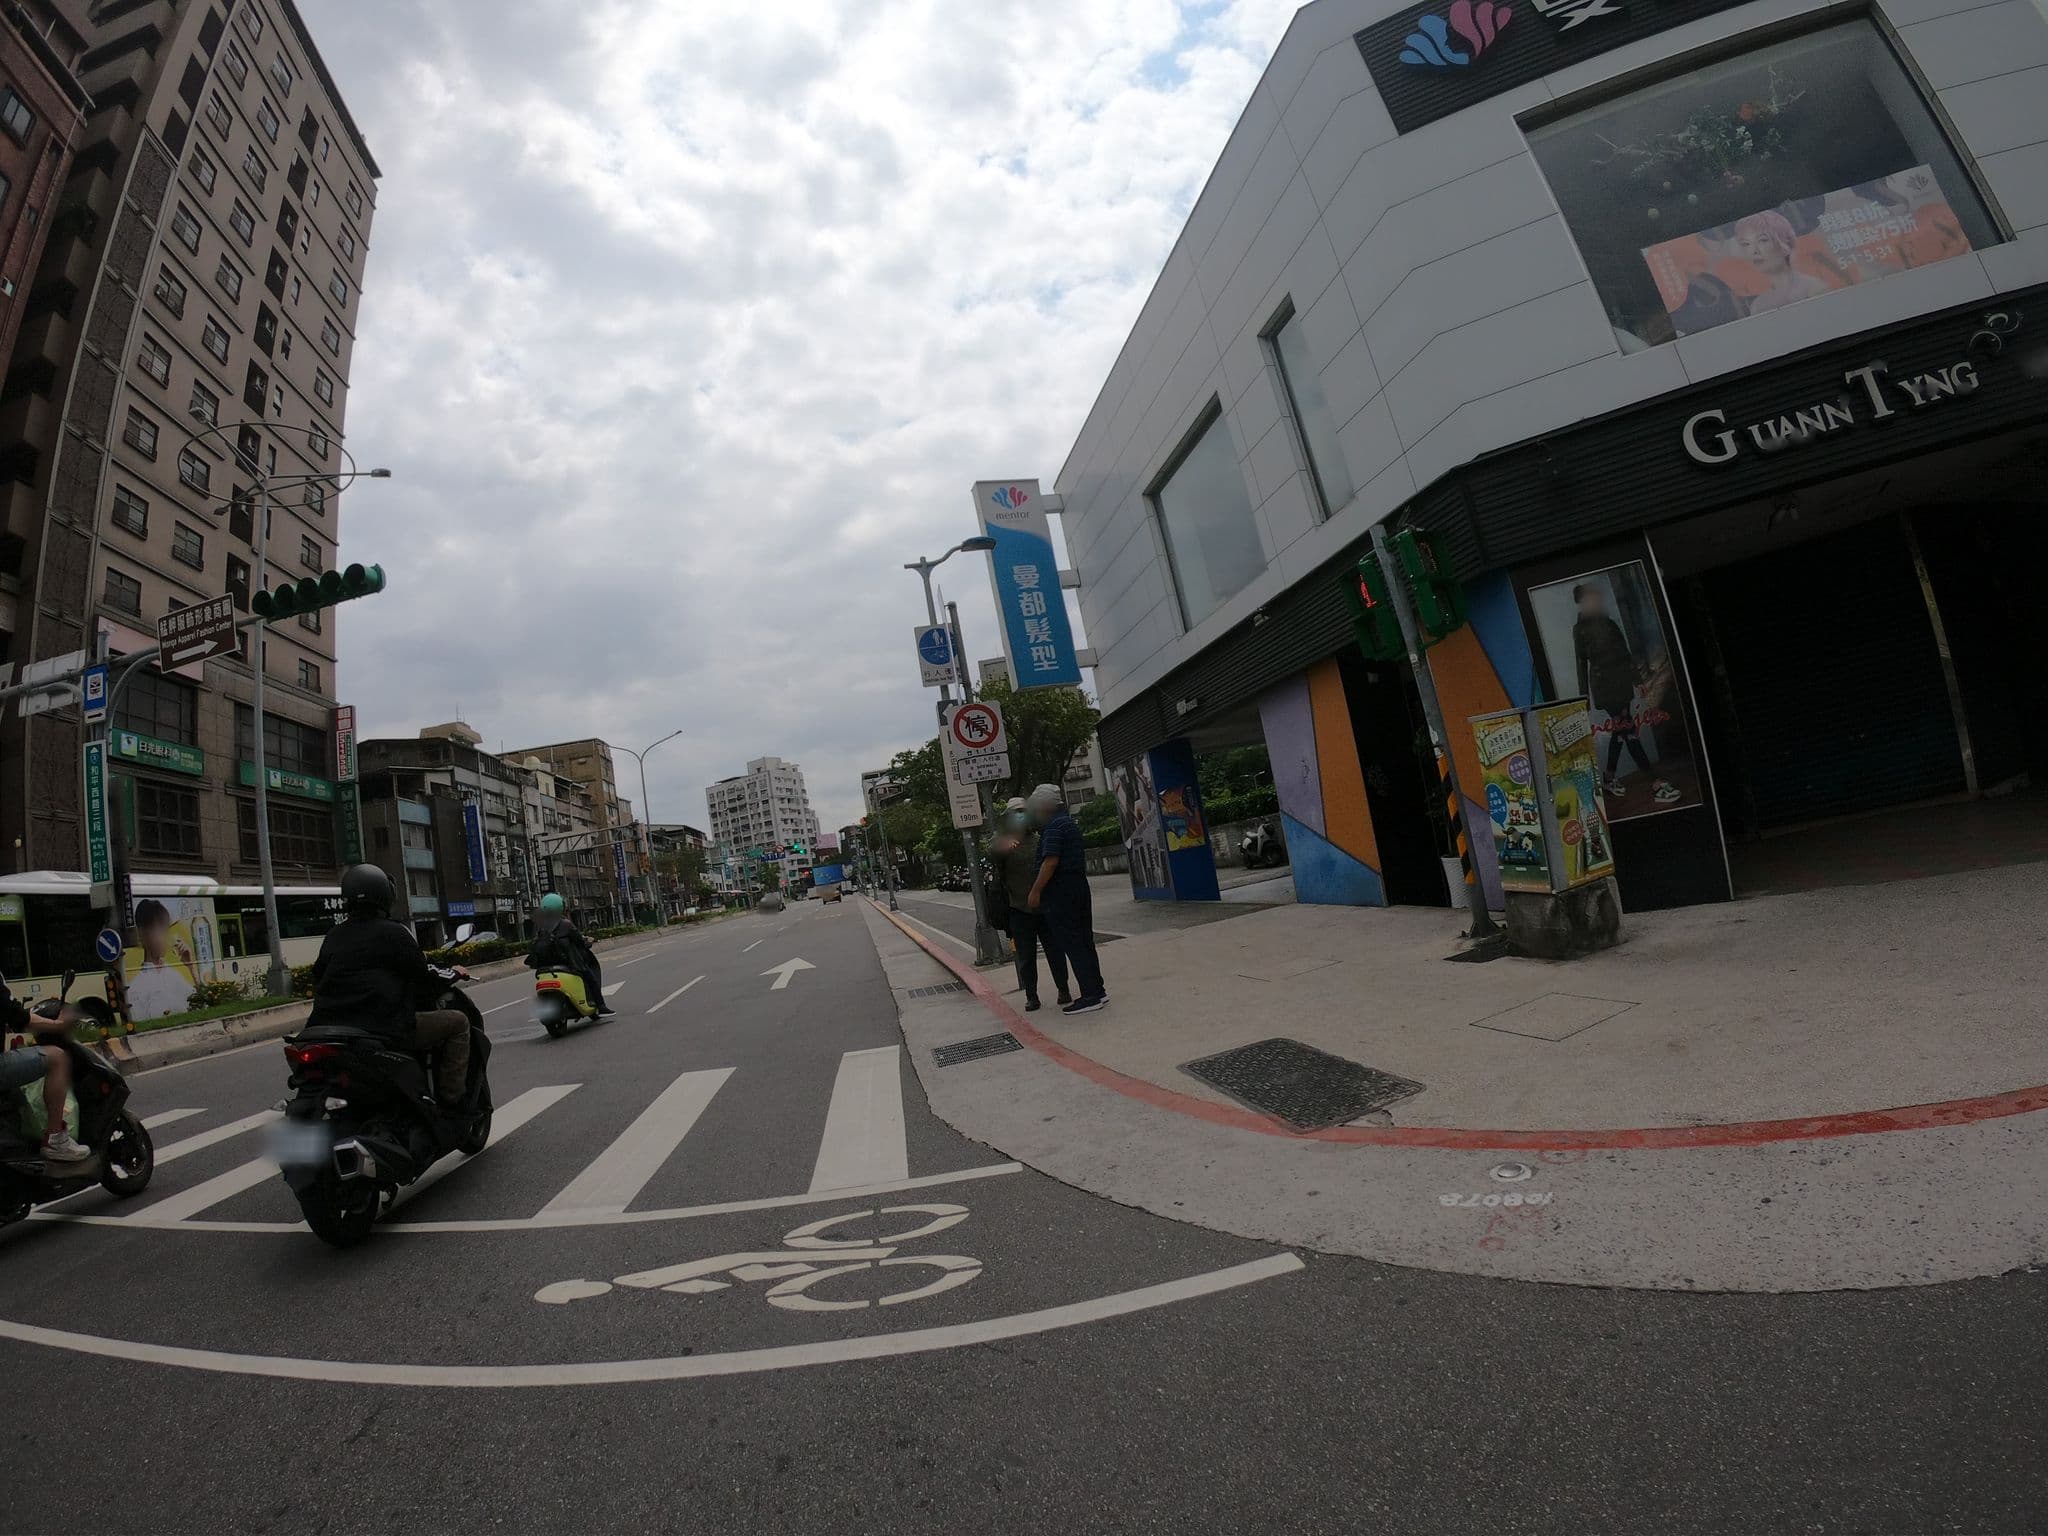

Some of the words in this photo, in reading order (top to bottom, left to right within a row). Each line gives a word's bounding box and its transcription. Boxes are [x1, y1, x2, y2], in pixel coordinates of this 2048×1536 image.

[995, 510, 1032, 521] mentor
[1012, 563, 1060, 672] 曼都髮型
[178, 631, 196, 644] Apparel
[197, 626, 215, 638] Fashion
[215, 621, 232, 632] Center
[965, 715, 989, 739] 停
[90, 765, 102, 833] 和平西路三段
